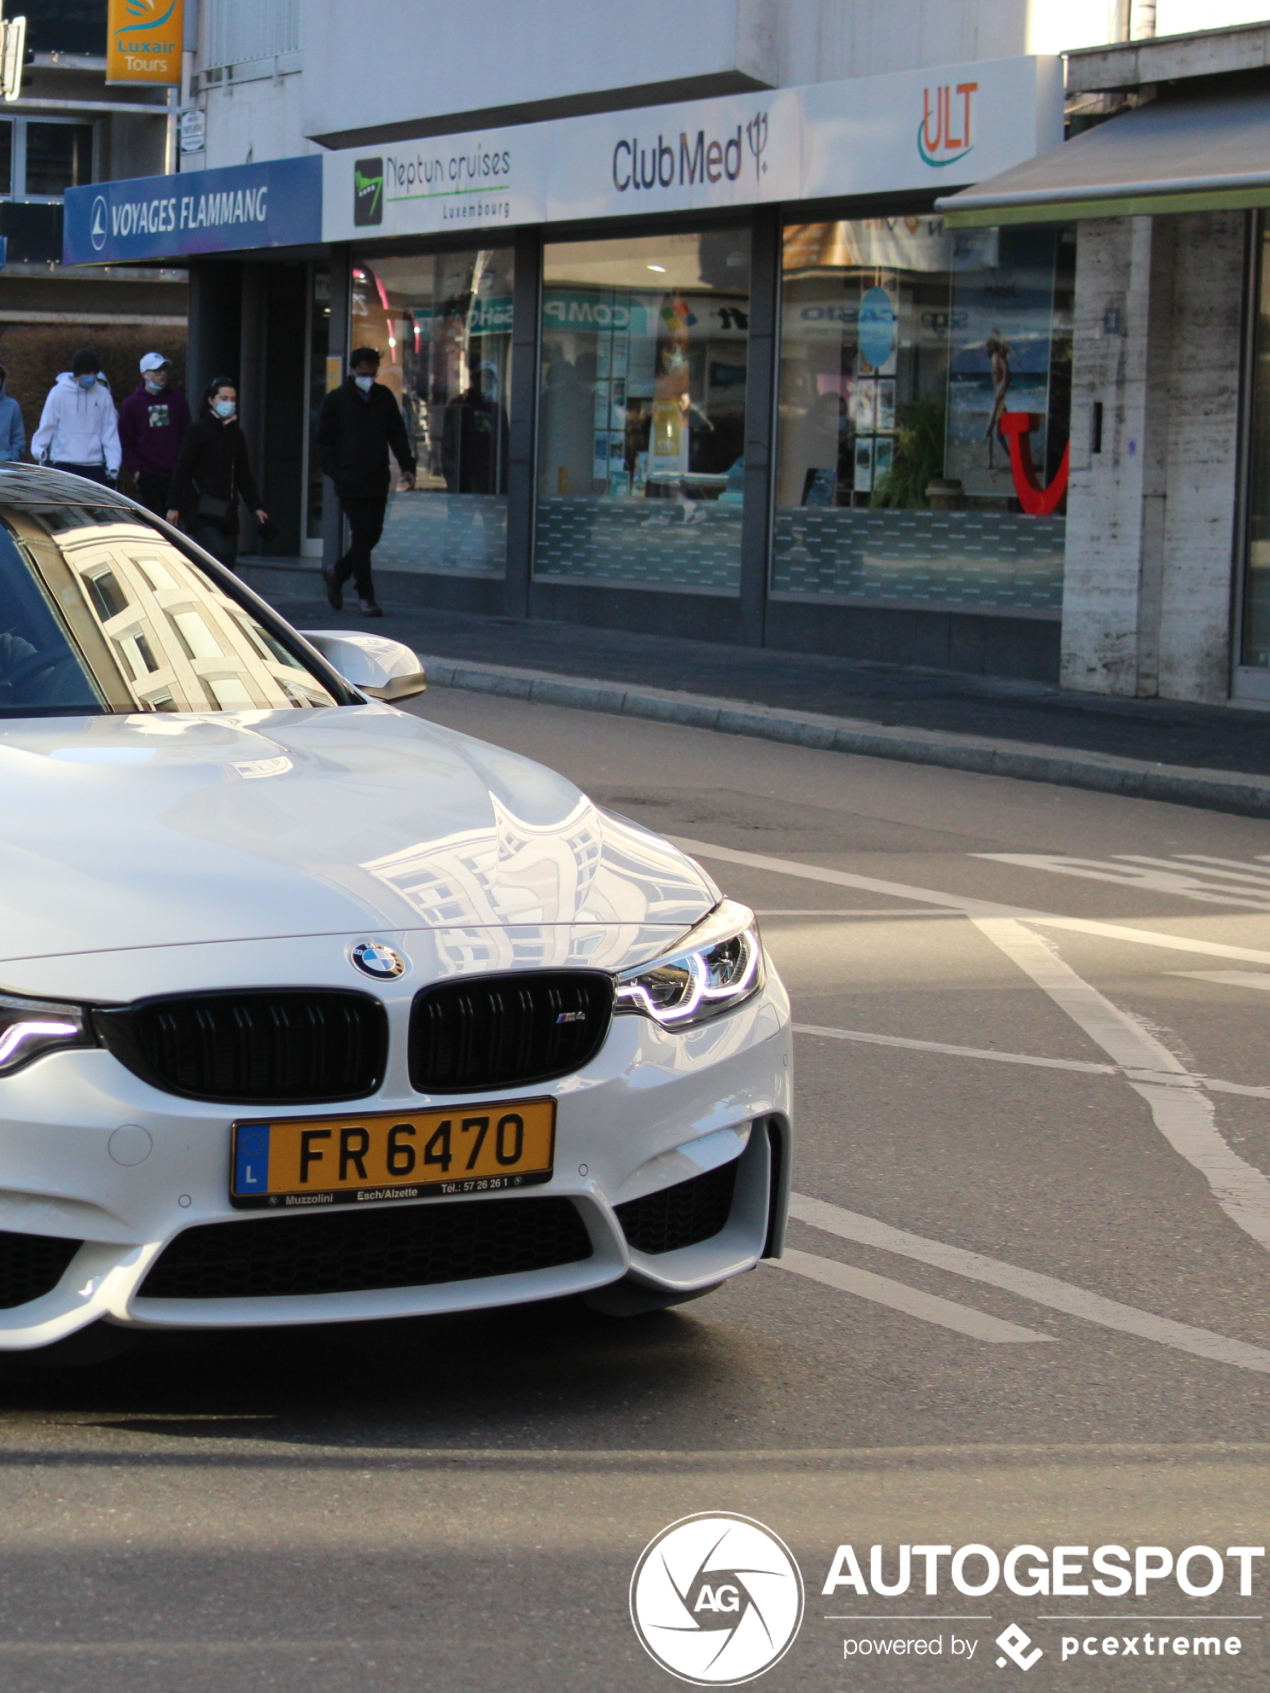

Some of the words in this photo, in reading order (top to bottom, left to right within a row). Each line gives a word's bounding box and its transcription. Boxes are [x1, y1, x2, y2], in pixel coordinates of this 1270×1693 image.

[117, 40, 176, 54] Luxair
[124, 55, 168, 72] Tours
[923, 82, 978, 153] ULT
[386, 155, 444, 188] Neptun
[448, 143, 511, 181] cruises
[612, 134, 675, 192] Club
[679, 125, 742, 186] Med
[111, 197, 176, 237] VOYAGES
[179, 186, 269, 230] FLAMMANG
[442, 201, 511, 220] Luxembourg
[299, 1126, 370, 1184] FR
[386, 1113, 524, 1177] 6470
[244, 1165, 258, 1184] L
[285, 1194, 334, 1206] Muzzolini
[357, 1187, 418, 1201] Esch/Alzette
[463, 1181, 476, 1192] 57
[476, 1180, 489, 1191] 26
[490, 1179, 502, 1190] 26
